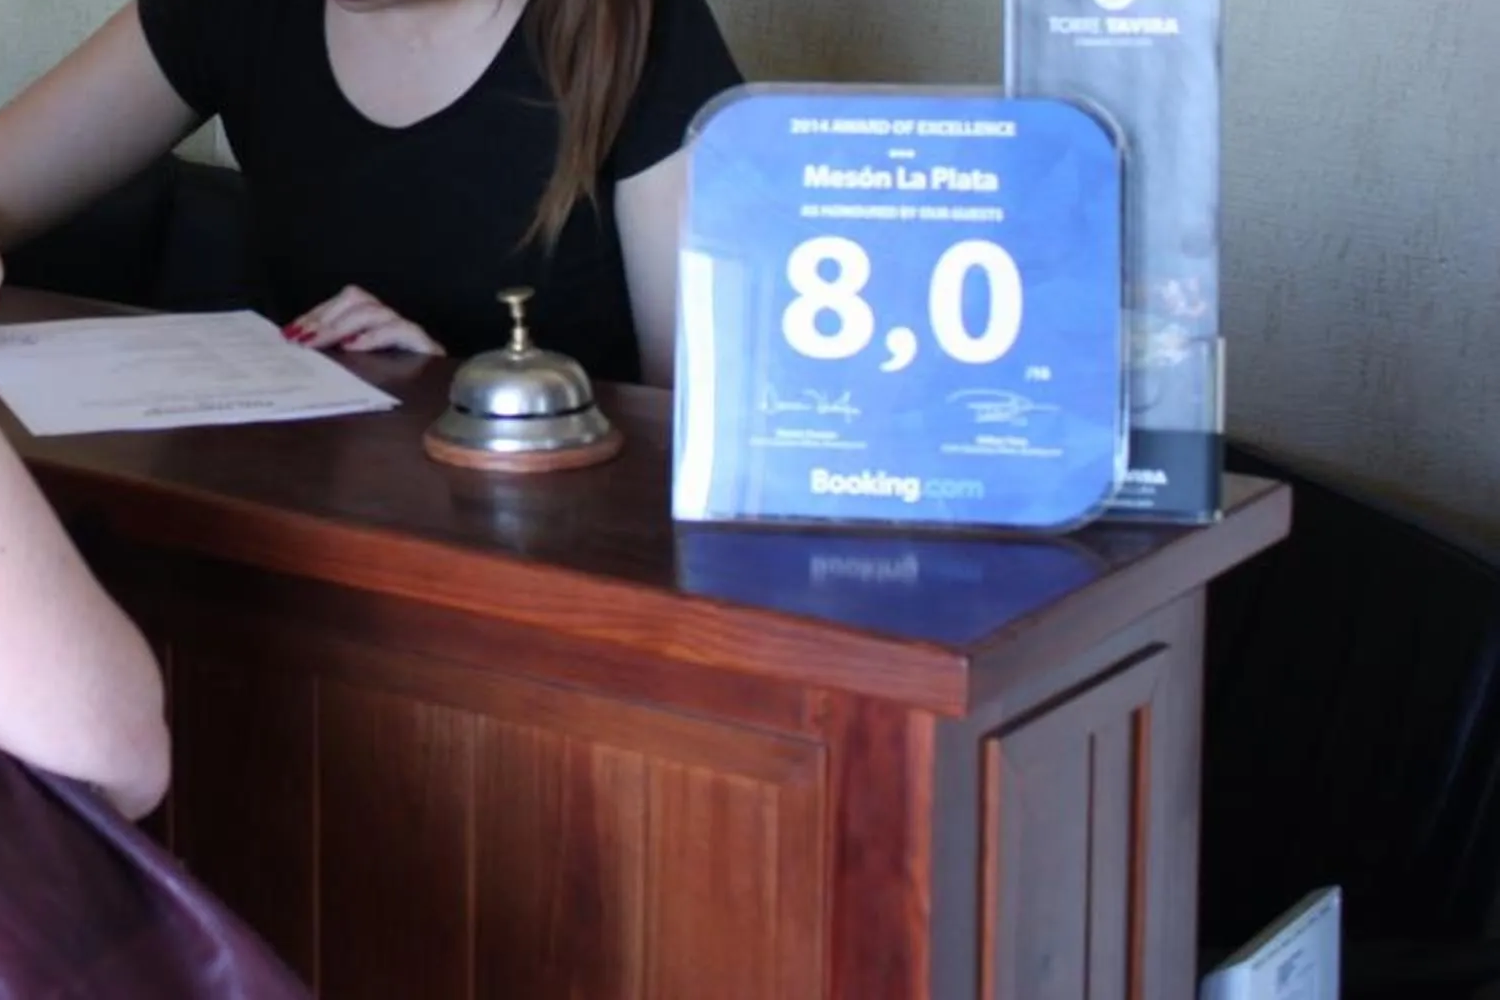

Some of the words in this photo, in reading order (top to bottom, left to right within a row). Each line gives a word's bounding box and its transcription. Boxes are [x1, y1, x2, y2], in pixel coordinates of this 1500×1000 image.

[831, 118, 890, 136] AWARD
[892, 119, 915, 136] OF
[917, 119, 1017, 138] EXCELLENCE
[803, 163, 893, 190] Mesón
[896, 166, 927, 191] La
[930, 166, 1000, 192] Plata
[781, 234, 1023, 374] 8,0
[810, 467, 985, 504] Booking.com
